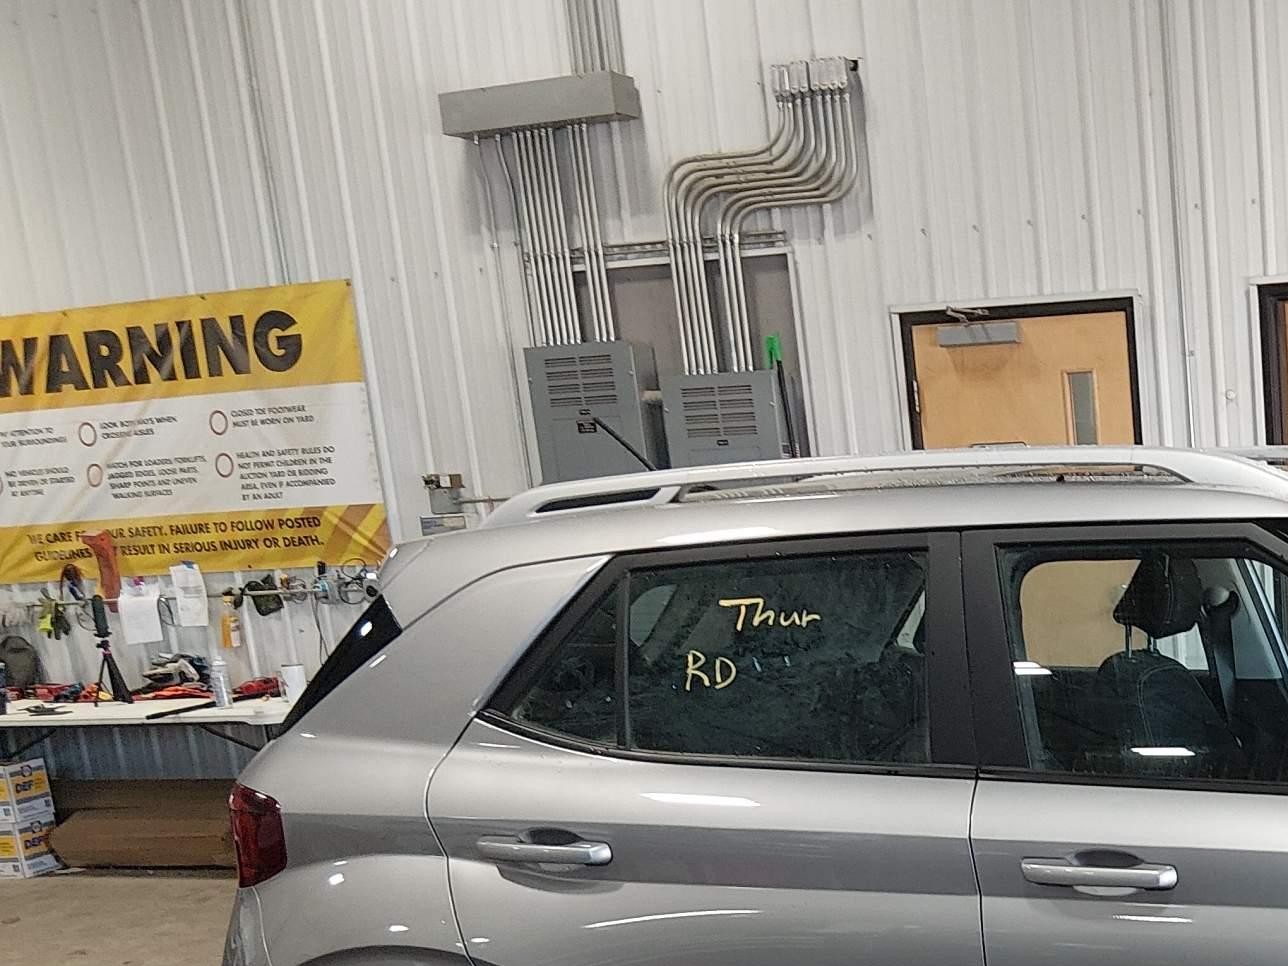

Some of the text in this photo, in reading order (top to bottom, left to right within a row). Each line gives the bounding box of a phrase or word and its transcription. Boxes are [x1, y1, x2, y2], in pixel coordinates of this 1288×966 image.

[268, 404, 306, 414] FOOTWEAR
[282, 416, 294, 424] ON
[277, 448, 299, 456] SAFETY
[322, 446, 335, 454] DO
[128, 526, 168, 538] SAFETY.
[170, 522, 211, 536] FAILURE
[213, 522, 228, 532] TO
[230, 518, 274, 532] FOLLOW
[278, 516, 321, 528] POSTED
[46, 531, 72, 543] CARE
[120, 544, 154, 556] RESULT
[158, 543, 170, 554] IN
[174, 540, 218, 554] SERIOUS
[219, 538, 260, 551] INJURY
[263, 536, 280, 548] OR
[283, 535, 324, 548] DEATH.
[718, 597, 822, 632] Thur
[684, 650, 737, 692] RD
